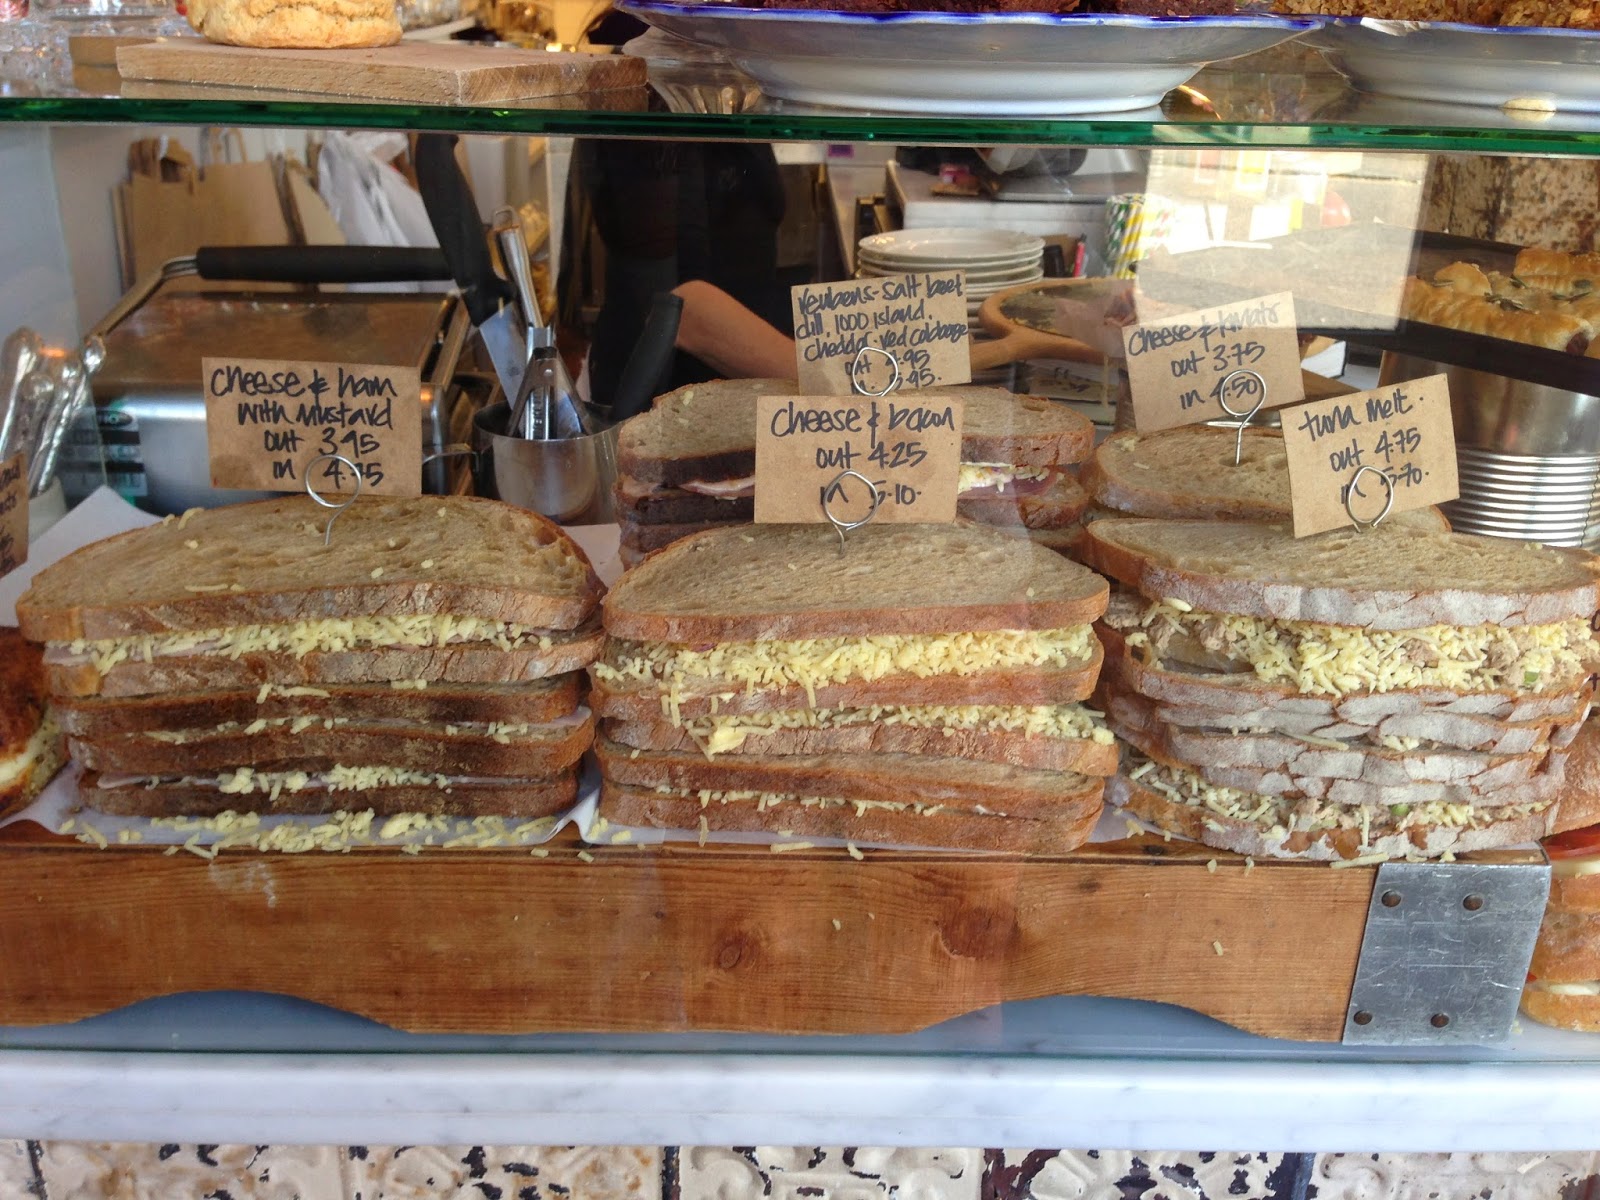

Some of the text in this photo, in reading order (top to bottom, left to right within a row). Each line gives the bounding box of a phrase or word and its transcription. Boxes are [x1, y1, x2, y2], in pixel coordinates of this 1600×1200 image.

[835, 312, 870, 335] 1000
[844, 354, 872, 376] out
[1171, 341, 1266, 377] out 3.75
[338, 368, 397, 398] ham
[888, 403, 955, 432] bacon
[1298, 405, 1361, 442] tuna
[264, 430, 304, 453] out
[816, 441, 861, 469] out
[1329, 427, 1422, 472] out 4.75
